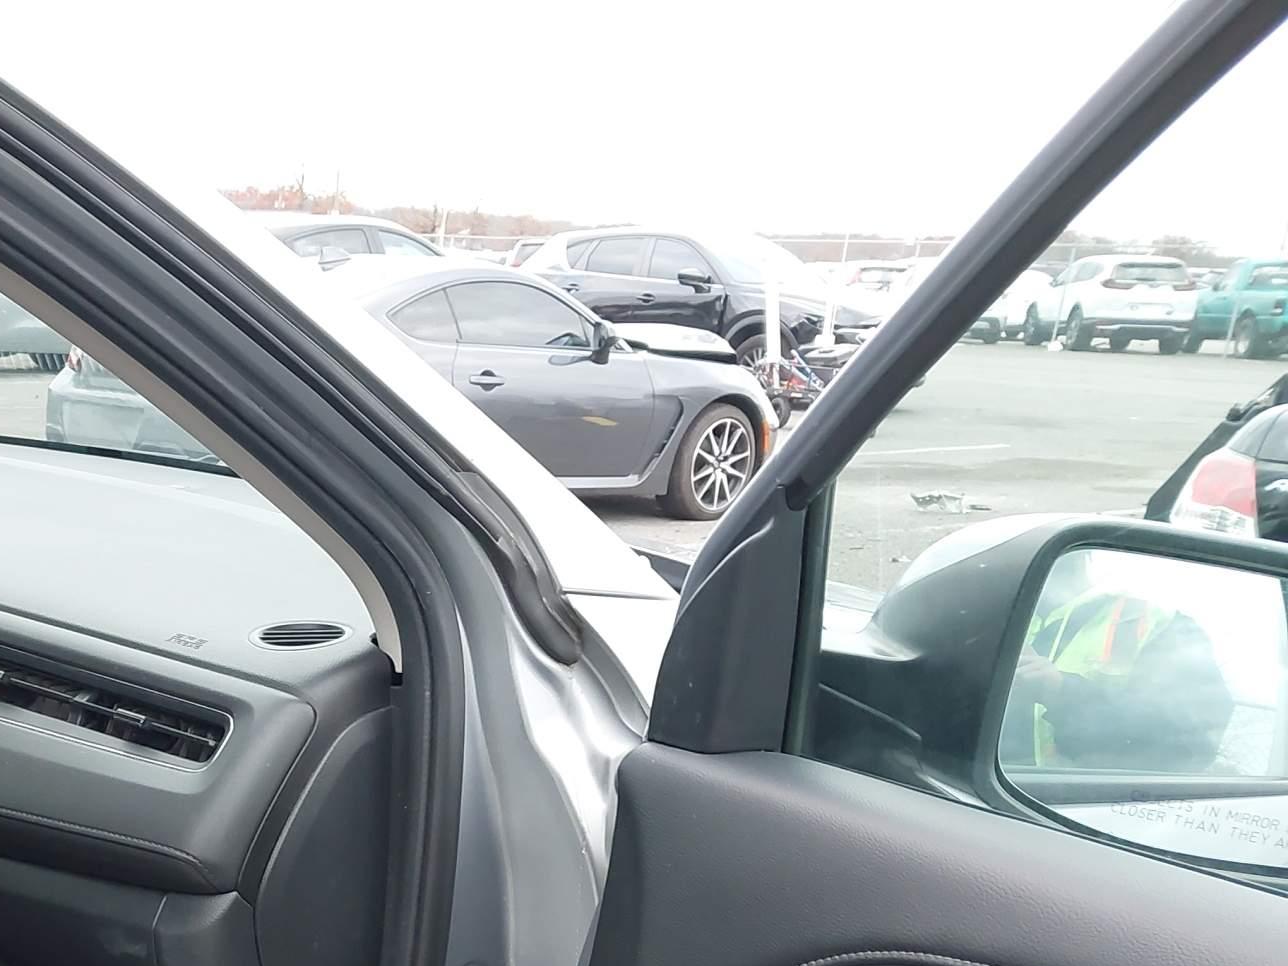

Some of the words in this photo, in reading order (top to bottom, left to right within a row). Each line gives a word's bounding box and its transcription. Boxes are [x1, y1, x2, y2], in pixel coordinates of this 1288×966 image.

[1110, 803, 1167, 823] CLOSER
[1174, 814, 1221, 835] THAN
[1230, 826, 1268, 845] THEY
[1203, 806, 1222, 818] IN
[1225, 809, 1281, 831] MIRROR
